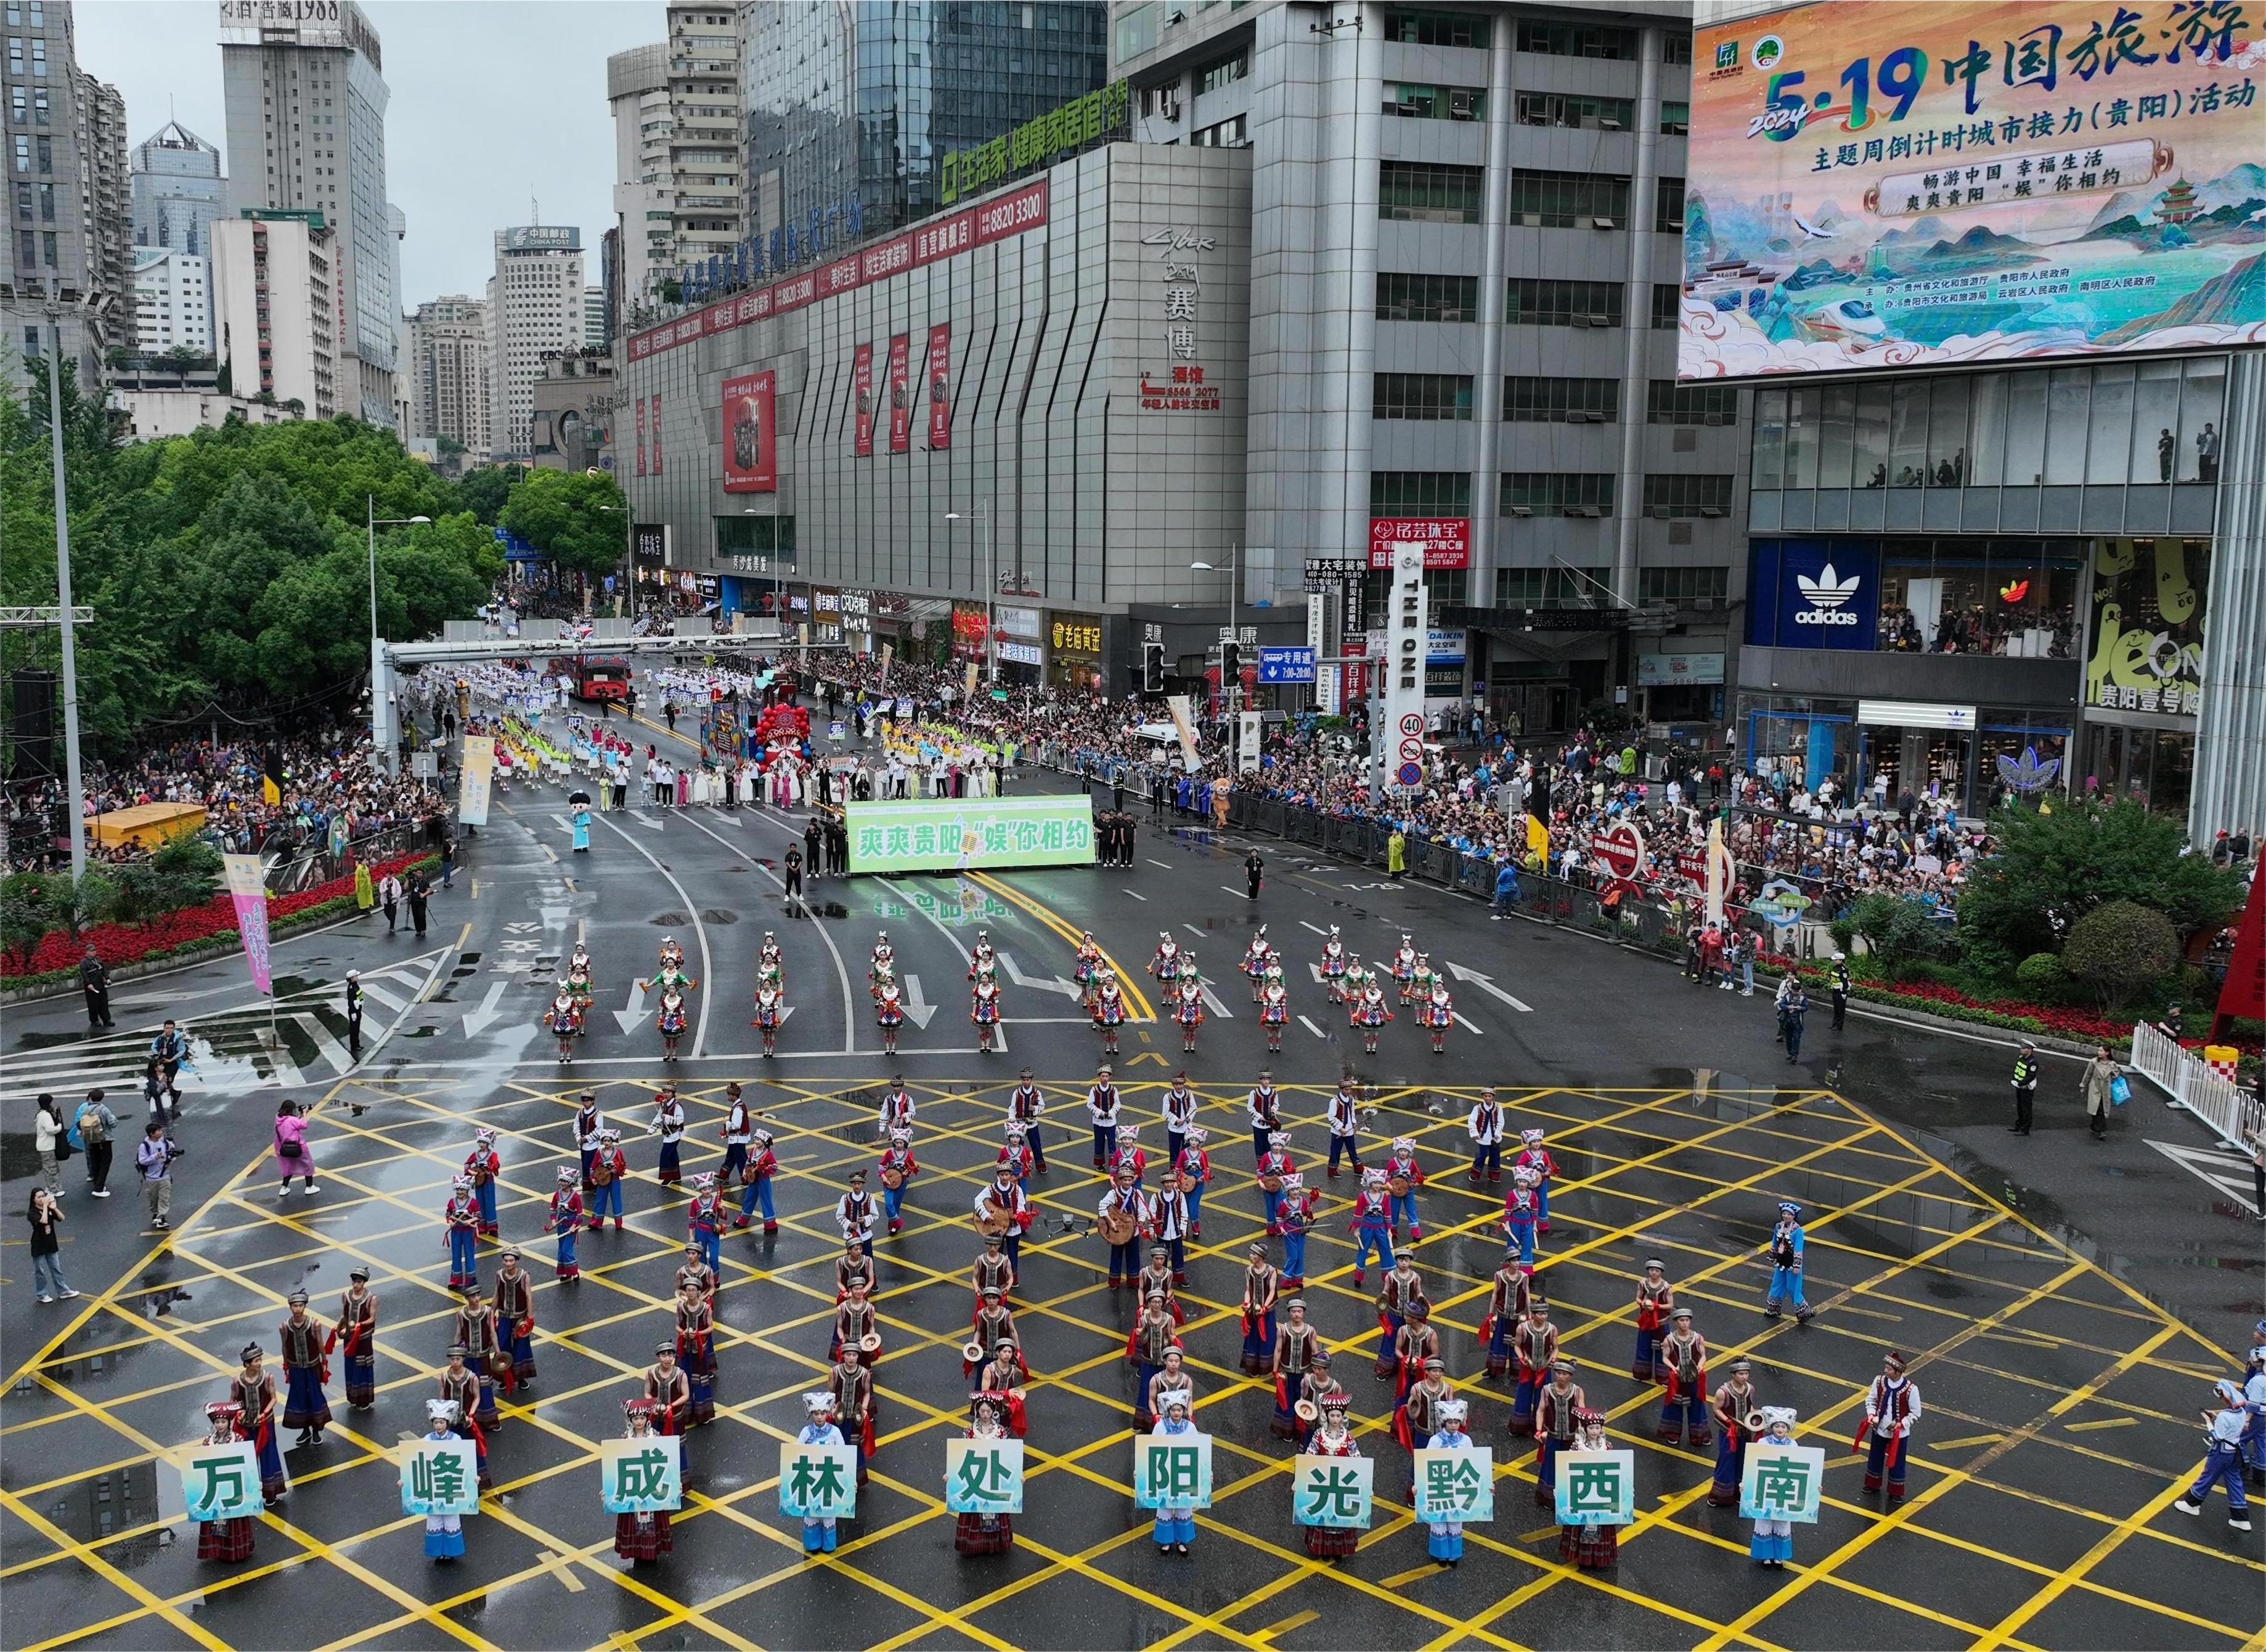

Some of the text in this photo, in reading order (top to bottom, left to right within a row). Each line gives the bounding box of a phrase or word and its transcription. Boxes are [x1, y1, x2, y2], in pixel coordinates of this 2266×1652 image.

[1746, 103, 1816, 140] 2024
[961, 89, 1101, 193] 生活家·健康家居馆
[1923, 150, 2103, 190] 畅游中国 幸福生活
[991, 205, 1014, 232] 8820
[1016, 193, 1040, 224] 3300
[530, 228, 569, 239] 中国邮政
[866, 242, 908, 279] 找生活家装饰
[919, 219, 968, 258] 直营旗舰店
[782, 283, 797, 304] 8820
[1902, 291, 1987, 308] 贵阳市文化和旅游局
[1997, 283, 2069, 300] 云岩区人民政府
[2079, 276, 2157, 293] 南明区人民政府
[1903, 275, 1989, 294] 贵州省文化和旅游厅
[1999, 268, 2070, 285] 贵阳市人民政府
[1164, 286, 1196, 362] 赛博
[1172, 366, 1204, 383] 酒馆
[1141, 399, 1220, 410] 年轻人的社交空间
[1396, 523, 1458, 539] 铭芸珠宝
[2094, 587, 2114, 603] NO!
[1795, 609, 1858, 625] adidas
[1065, 623, 1101, 652] 老庙黄金
[1144, 622, 1162, 642] 奥康
[1219, 627, 1258, 644] 奥康
[1401, 579, 1419, 690] THE ONE
[1006, 643, 1037, 662] 生活家装饰
[1283, 651, 1311, 664] 专用道
[2160, 654, 2175, 663] THE
[1282, 667, 1311, 678] 7:00-20:00
[528, 698, 542, 709] 贵
[696, 693, 709, 704] 明
[1404, 718, 1419, 733] 40
[1341, 882, 1406, 892] 7-20
[194, 1457, 245, 1512] 万
[412, 1454, 462, 1504] 峰
[617, 1450, 669, 1502] 成
[791, 1456, 844, 1507] 林
[959, 1452, 1011, 1502] 处
[1149, 1448, 1198, 1498] 阳
[1428, 1460, 1480, 1512] 黔
[1755, 1458, 1809, 1512] 南
[1308, 1467, 1359, 1516] 光
[1570, 1463, 1620, 1514] 西
